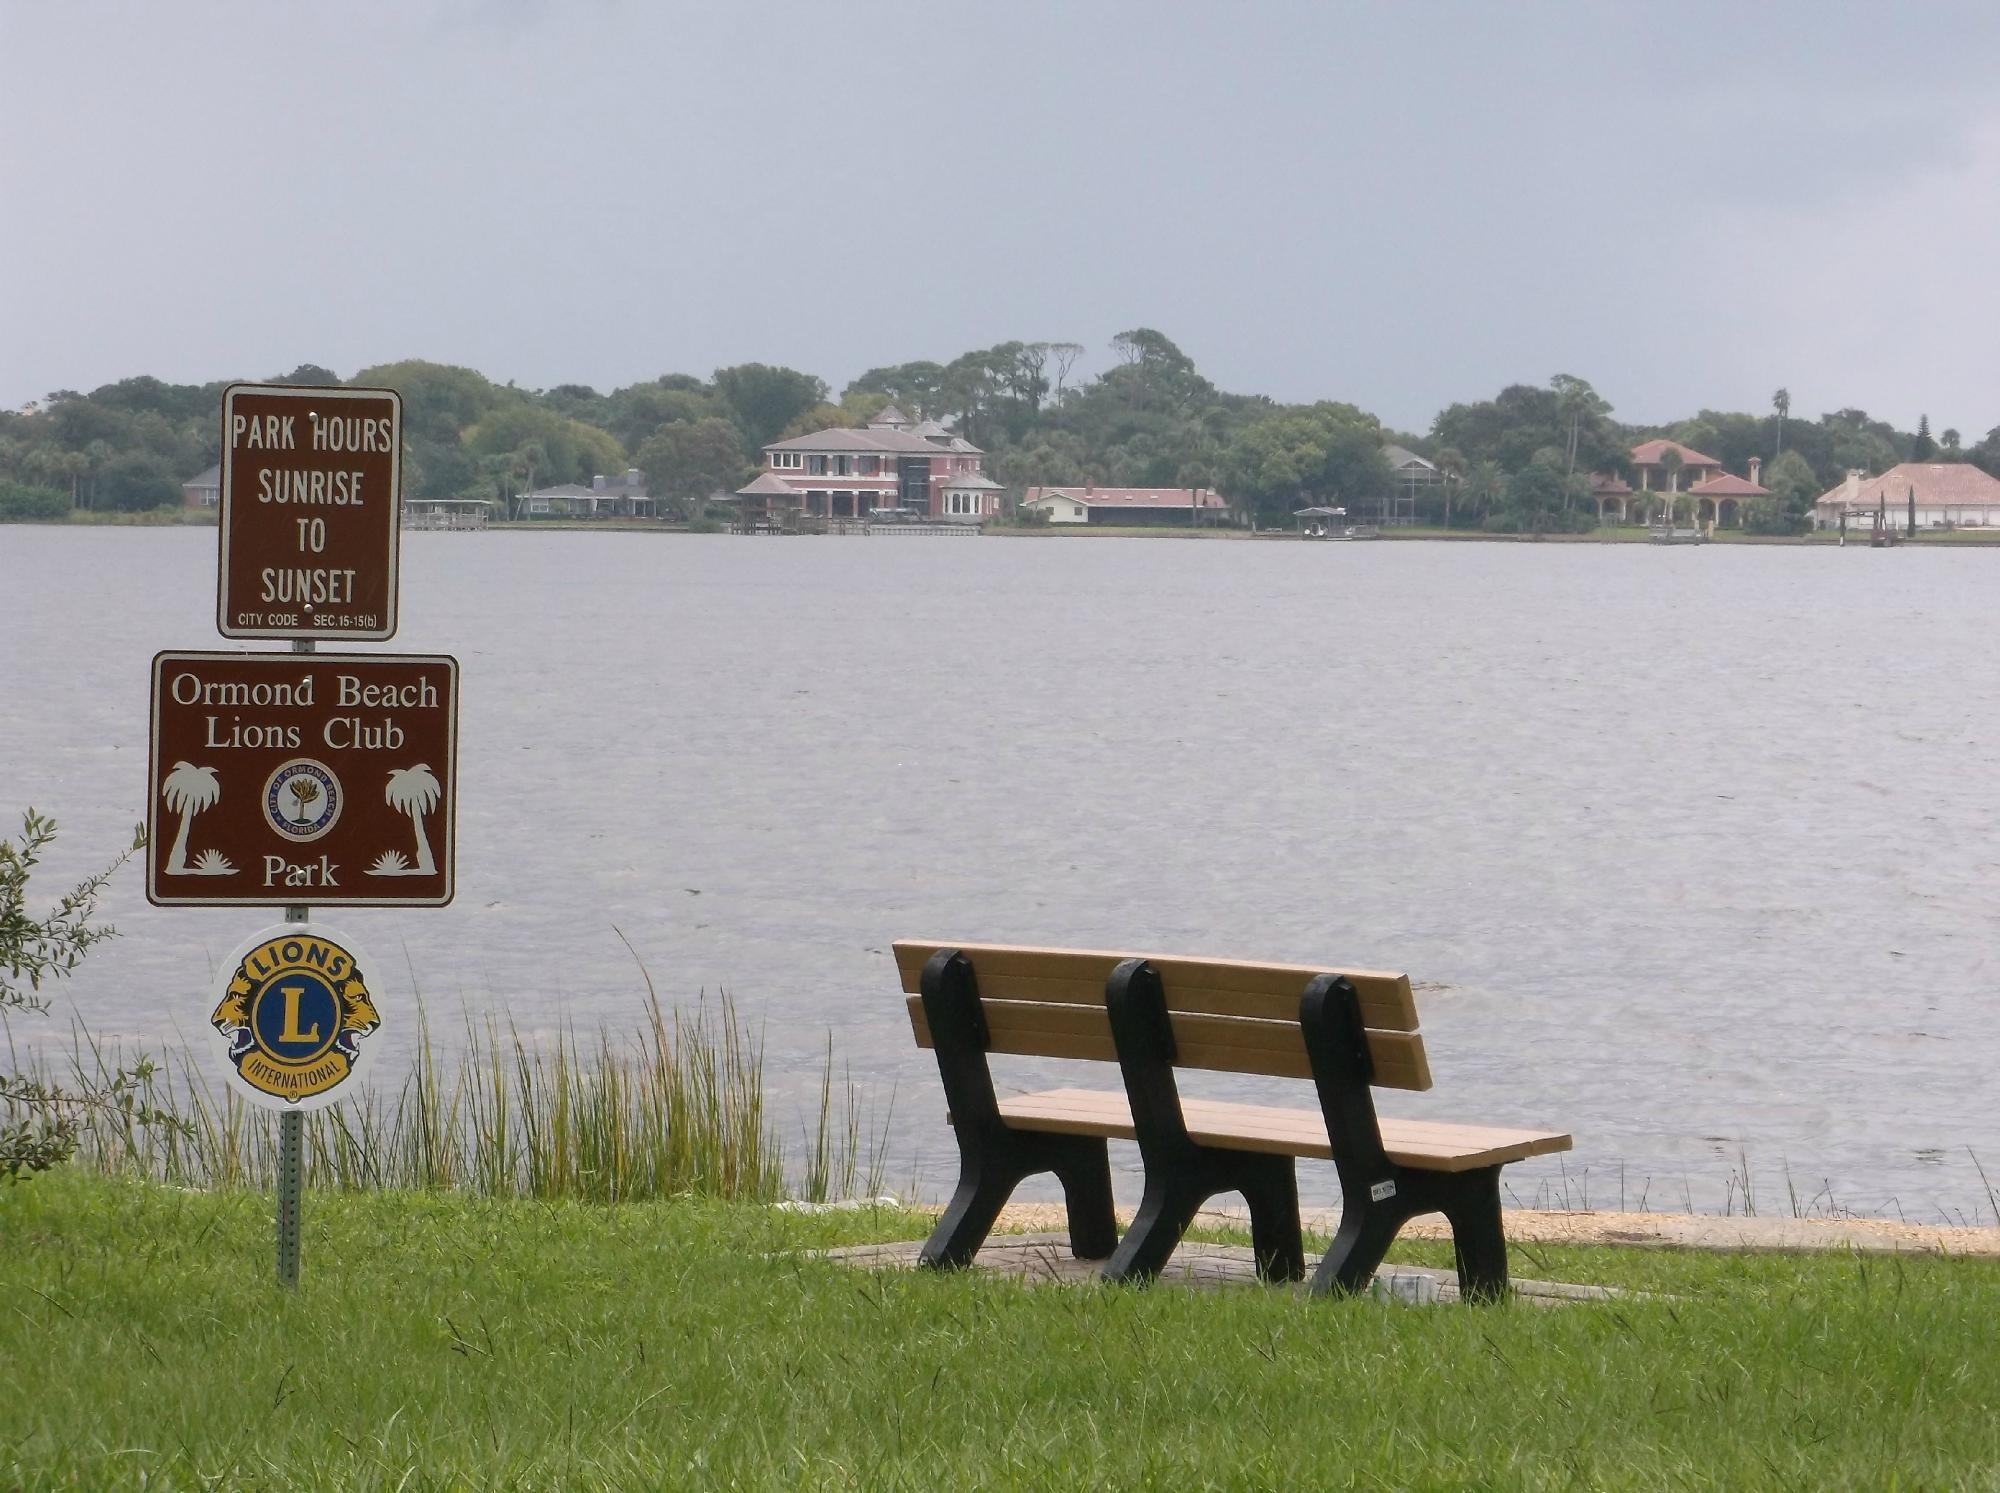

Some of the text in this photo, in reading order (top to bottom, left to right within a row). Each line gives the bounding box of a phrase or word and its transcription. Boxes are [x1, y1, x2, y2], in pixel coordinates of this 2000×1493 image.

[233, 414, 392, 452] PARK HOURS
[258, 468, 364, 505] SUNRISE
[297, 518, 326, 553] TO
[261, 568, 356, 603] SUNSET
[238, 613, 263, 626] CITY
[268, 614, 298, 626] CODE
[172, 673, 439, 708] Ormond Beach
[204, 716, 405, 750] Lions Club
[270, 793, 278, 814] CITY
[285, 766, 327, 782] ORMOND
[326, 784, 335, 816] BEACH
[282, 822, 320, 834] FLORIDA
[262, 855, 340, 888] Park
[251, 941, 347, 977] LIONS
[278, 987, 320, 1043] L
[248, 1058, 341, 1089] INTERNATIONAL
